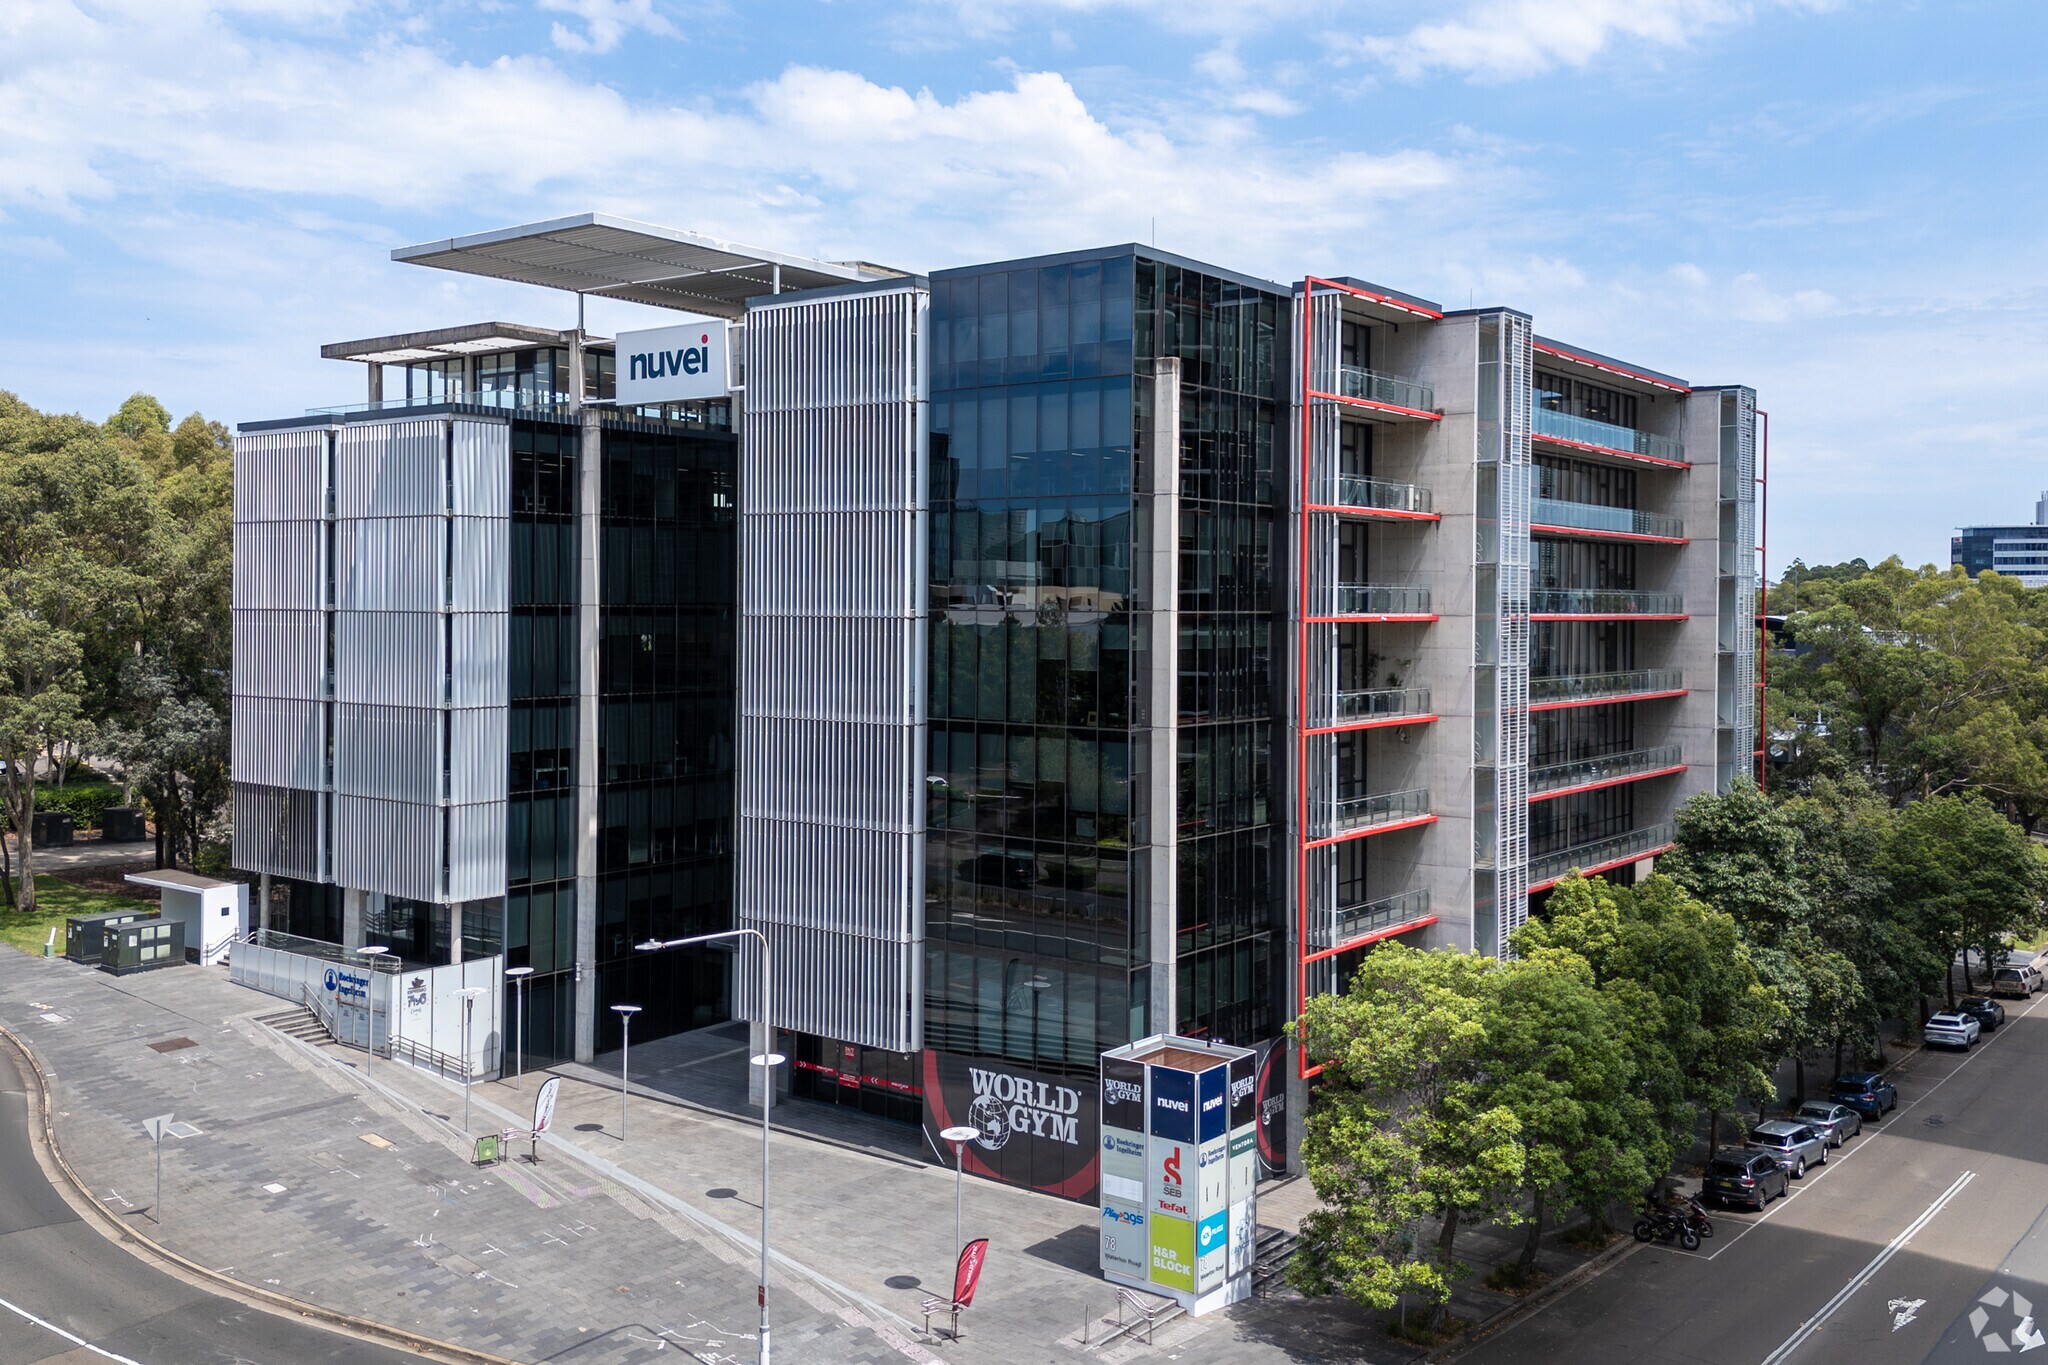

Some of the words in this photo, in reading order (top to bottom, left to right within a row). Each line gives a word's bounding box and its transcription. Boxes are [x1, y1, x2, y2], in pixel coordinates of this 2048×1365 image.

[630, 333, 708, 380] nuvei
[969, 1067, 1079, 1115] WORLD
[1104, 1078, 1142, 1093] WORLD
[1231, 1076, 1254, 1090] WORLD
[1239, 1084, 1254, 1097] GYM
[1118, 1090, 1141, 1103] GYM
[1203, 1092, 1223, 1112] nuvei
[1262, 1093, 1284, 1110] WORLD
[1157, 1097, 1189, 1113] nuvei
[1270, 1102, 1284, 1115] GYM
[1008, 1104, 1079, 1145] GYM
[1116, 1138, 1144, 1150] Boehringer
[1116, 1145, 1142, 1157] Ingelheim
[1163, 1186, 1182, 1198] SEB
[1158, 1199, 1188, 1215] Tefal
[1105, 1235, 1117, 1251] 78
[1104, 1252, 1127, 1264] Waterloo
[1128, 1258, 1142, 1269] Road
[1153, 1245, 1177, 1260] H&R
[1153, 1256, 1191, 1276] BLOCK
